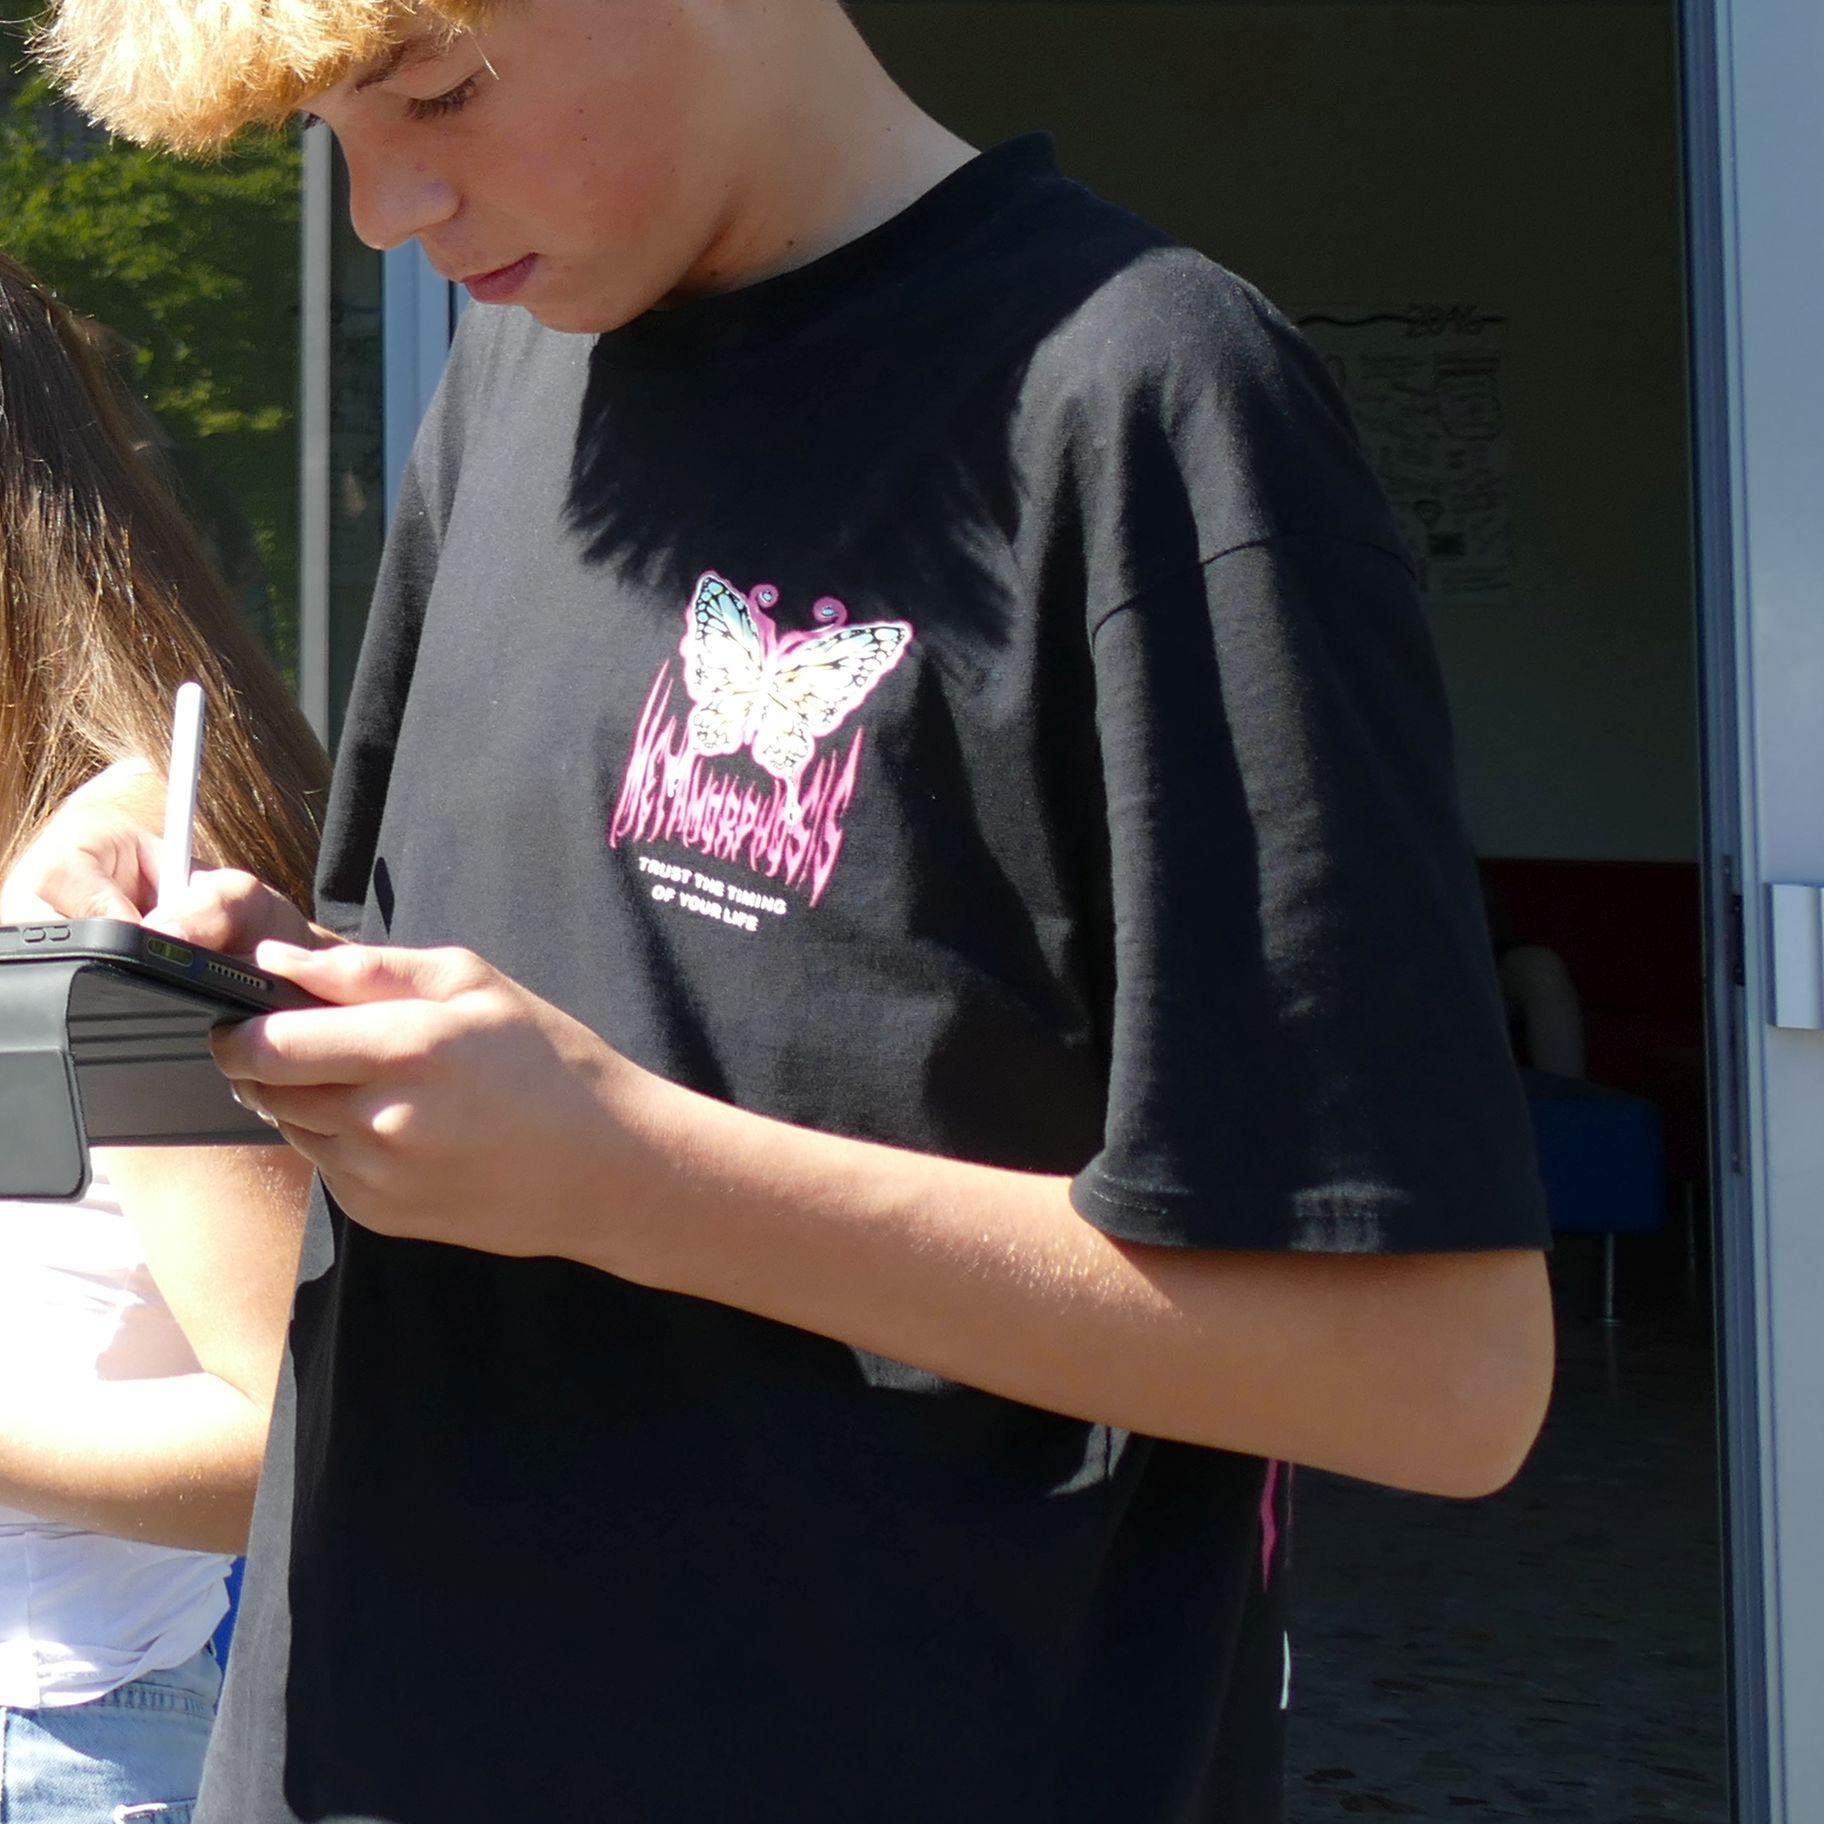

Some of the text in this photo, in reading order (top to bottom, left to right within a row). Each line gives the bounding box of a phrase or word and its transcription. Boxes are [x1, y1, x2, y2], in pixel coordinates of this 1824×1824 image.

[638, 856, 787, 915] TRUST THE TIMING
[652, 884, 759, 932] OF YOUR LIFE
